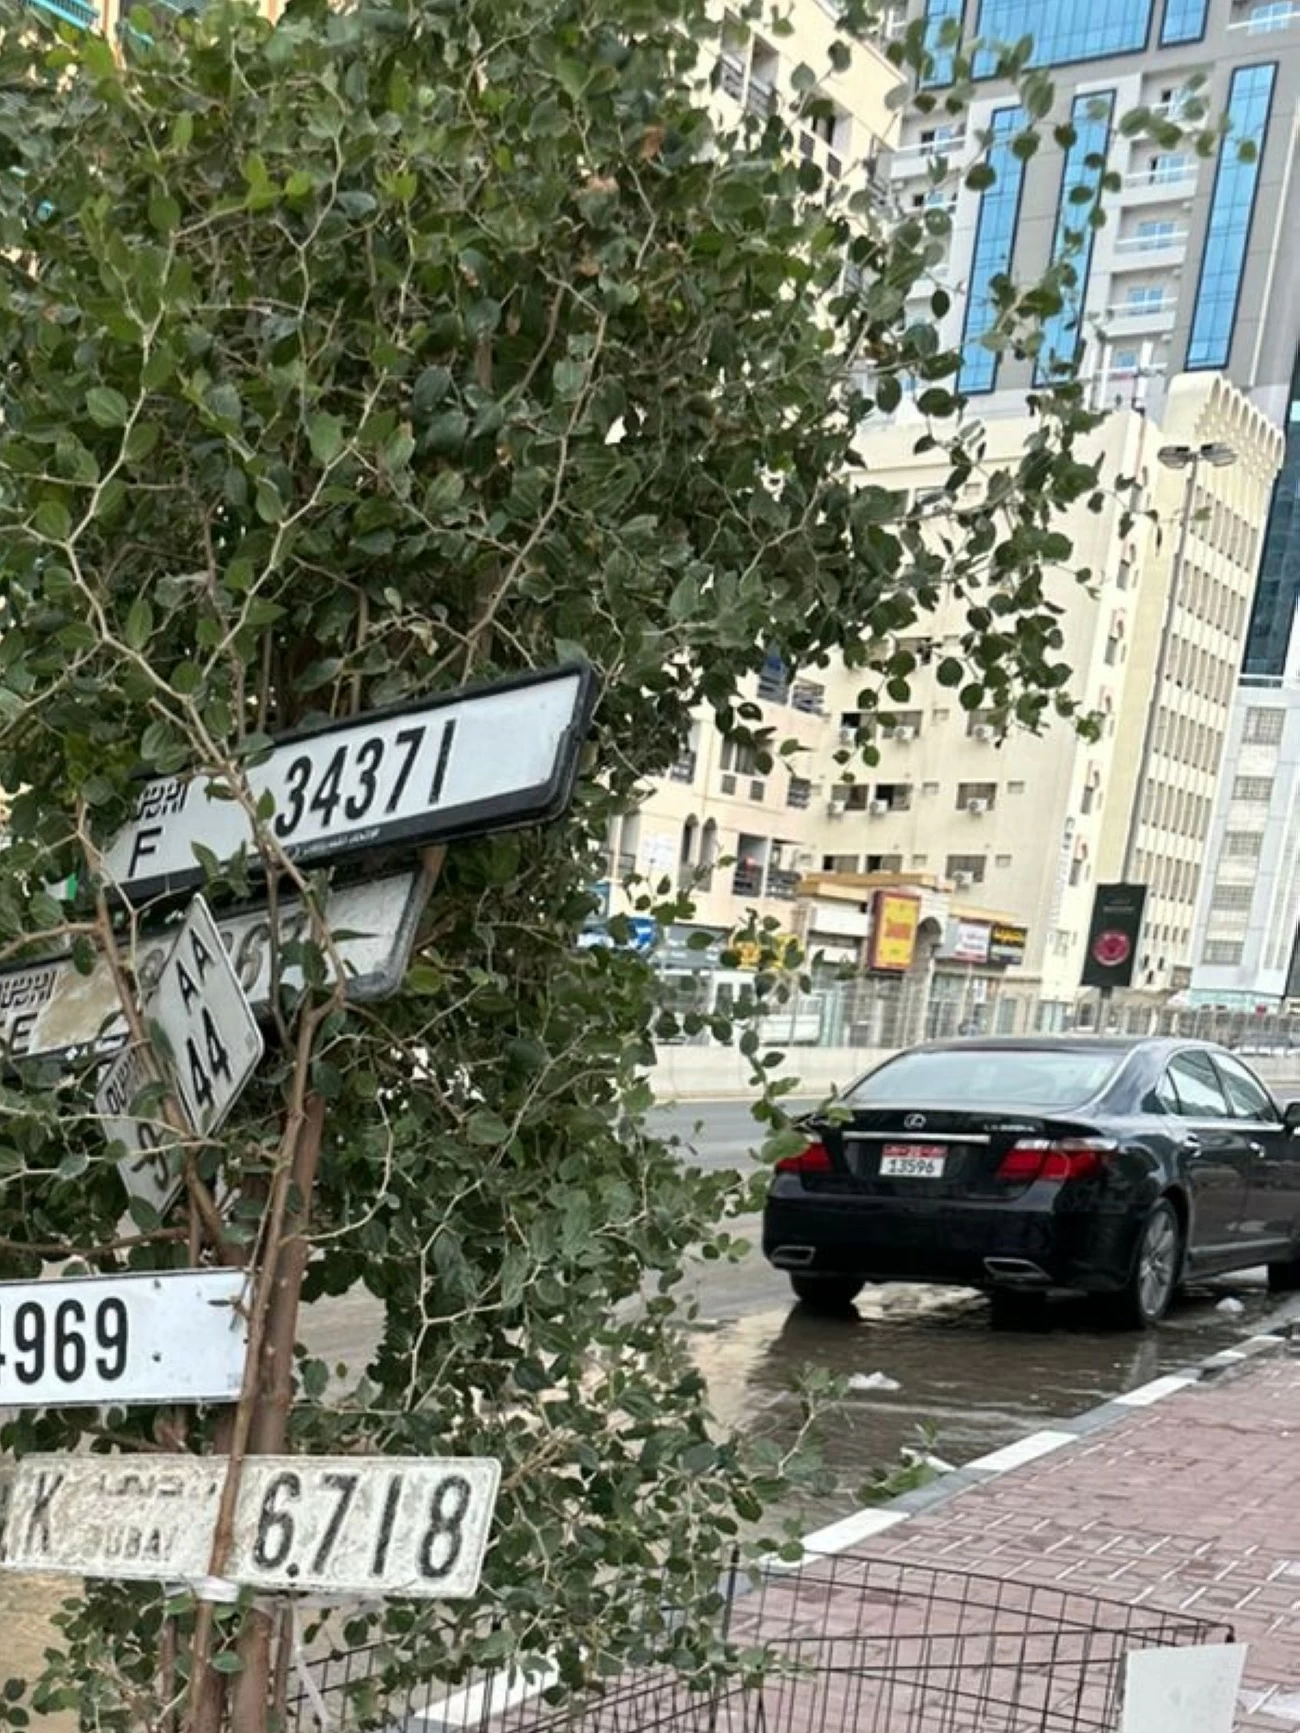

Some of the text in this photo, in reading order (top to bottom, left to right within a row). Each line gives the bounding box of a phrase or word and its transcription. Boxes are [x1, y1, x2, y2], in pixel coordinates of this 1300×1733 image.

[274, 719, 457, 838] 34371
[128, 826, 163, 878] F
[10, 1013, 37, 1055] E
[186, 1006, 233, 1108] 44
[25, 1472, 64, 1555] K
